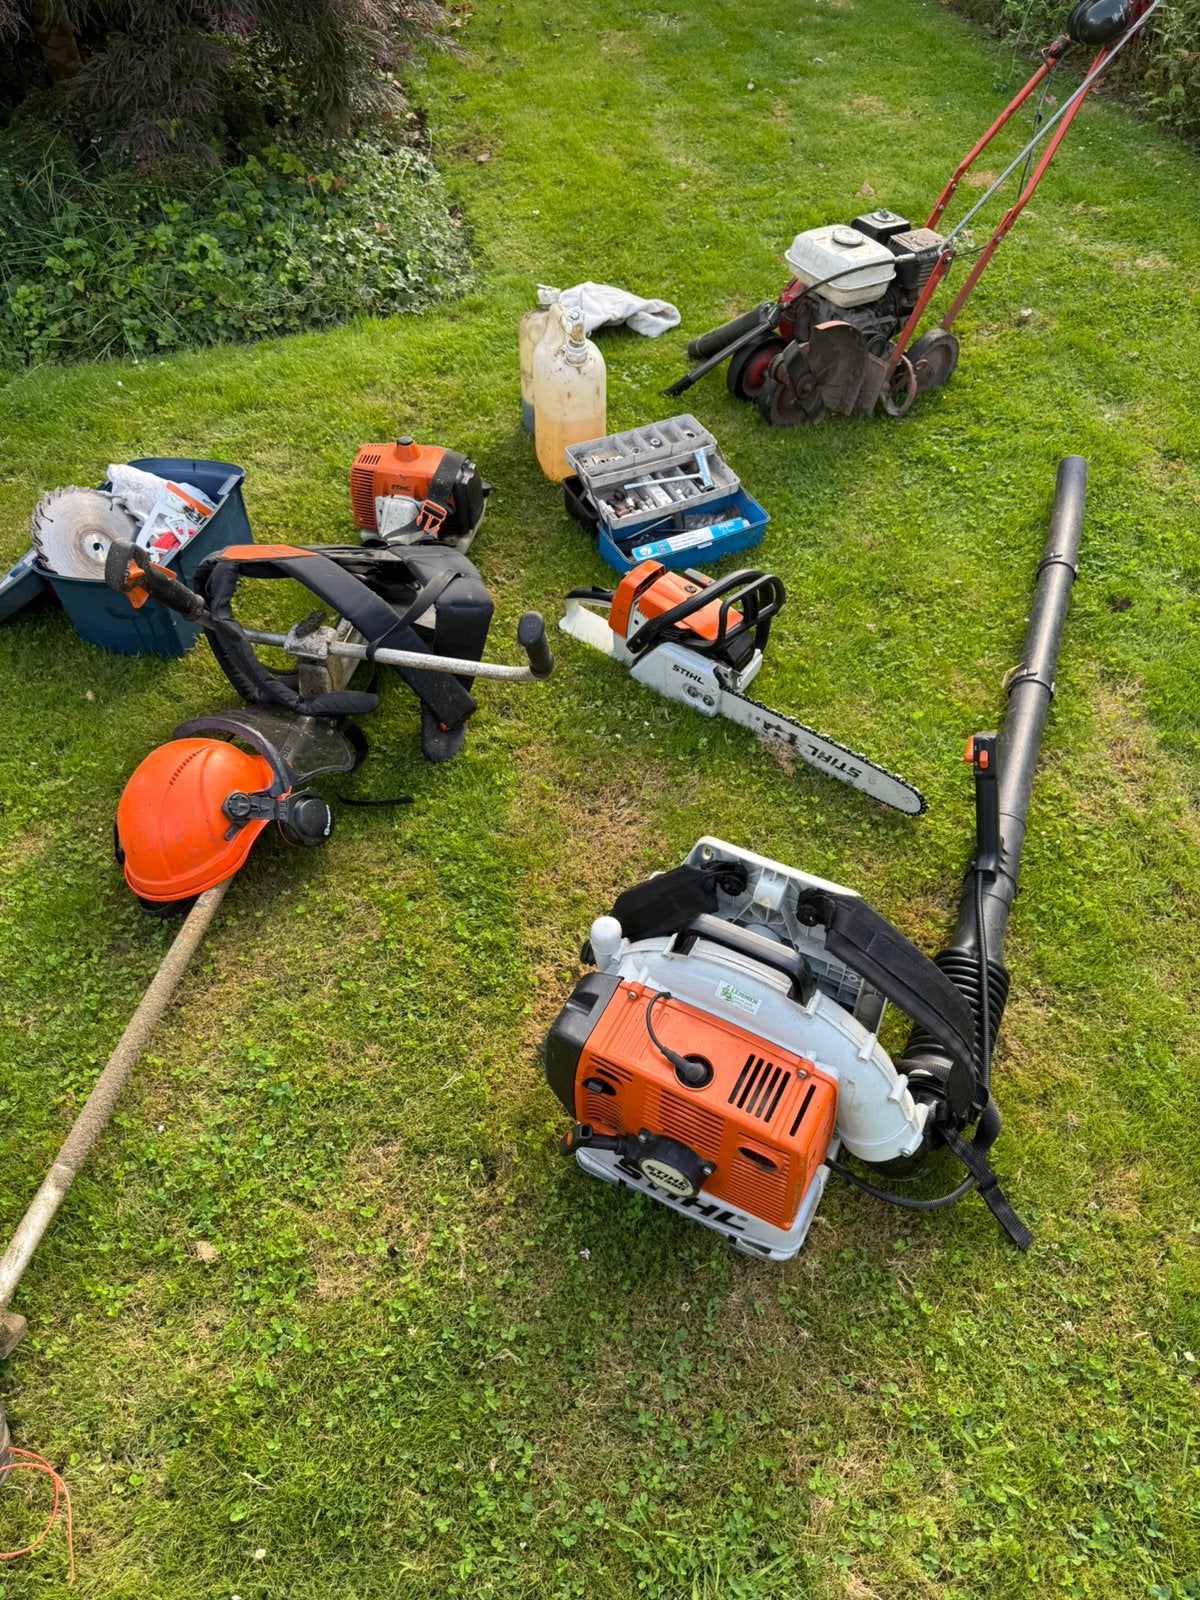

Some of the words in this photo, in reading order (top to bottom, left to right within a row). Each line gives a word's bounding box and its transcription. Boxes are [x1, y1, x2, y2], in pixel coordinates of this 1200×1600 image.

[672, 664, 704, 685] STIHL
[808, 744, 862, 778] STIHL
[645, 1164, 688, 1189] STIHL
